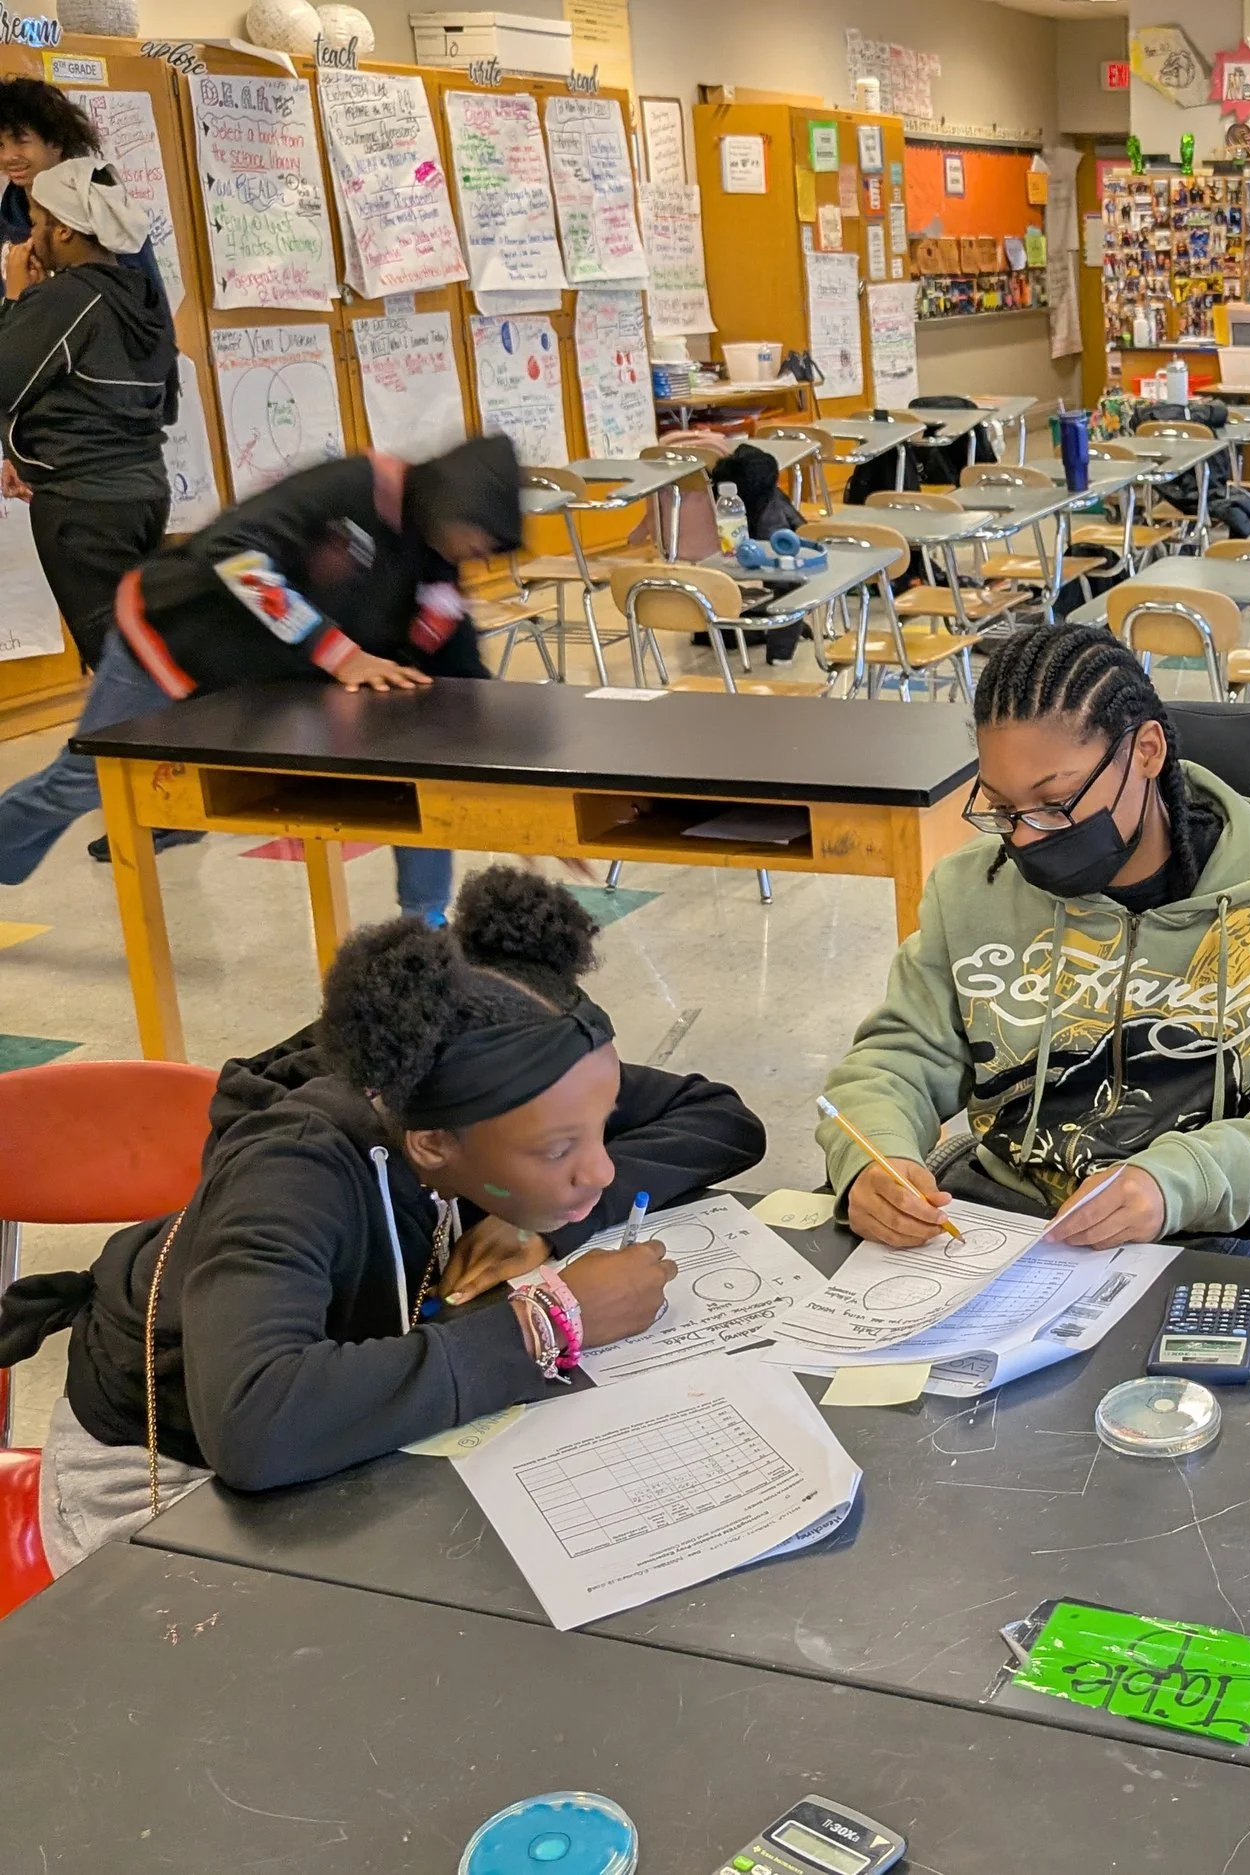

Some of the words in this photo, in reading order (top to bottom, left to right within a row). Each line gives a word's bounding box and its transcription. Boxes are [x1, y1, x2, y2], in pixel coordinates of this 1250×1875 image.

[140, 40, 206, 76] explore
[315, 32, 359, 68] teach
[67, 62, 97, 77] GRADE
[468, 57, 501, 86] write
[1109, 64, 1129, 88] EXI
[568, 65, 599, 93] read
[210, 123, 243, 141] Select
[231, 150, 265, 168] science
[952, 943, 1067, 1003] Ed
[723, 1231, 738, 1240] 2
[731, 1299, 773, 1314] describe
[842, 1309, 866, 1320] using
[680, 1318, 698, 1329] you
[700, 1311, 726, 1324] what
[705, 1310, 775, 1332] Qualitative
[624, 1332, 655, 1345] using
[662, 1330, 706, 1346] Data
[852, 1325, 881, 1337] Data
[723, 1510, 770, 1535] EvolvingSTEM
